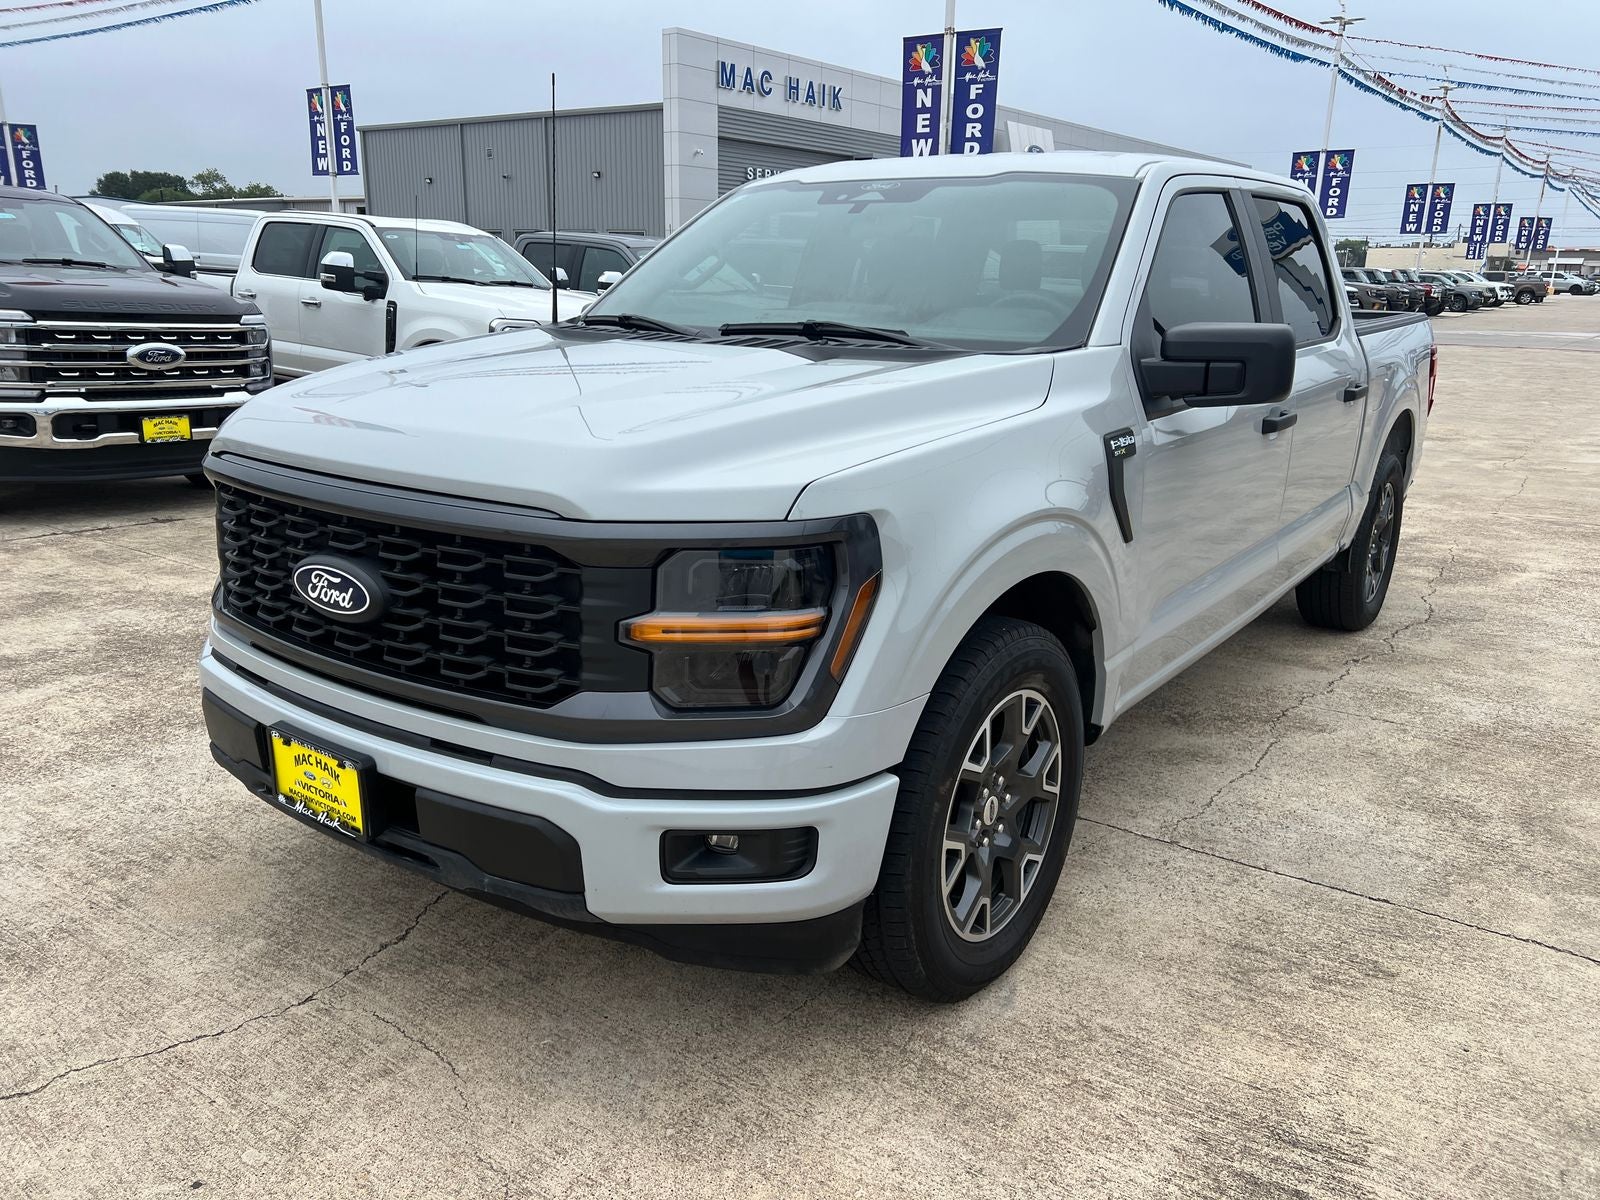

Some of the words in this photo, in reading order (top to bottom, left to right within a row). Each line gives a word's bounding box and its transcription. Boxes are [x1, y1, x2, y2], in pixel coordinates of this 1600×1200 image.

[717, 60, 773, 98] MAC
[785, 75, 842, 110] HAIK
[911, 88, 933, 157] NEW
[963, 84, 984, 156] FORD
[316, 122, 328, 171] NEW
[340, 122, 352, 171] FORD
[22, 150, 37, 187] FORD
[1326, 178, 1342, 216] FORD
[1405, 203, 1419, 232] NEW
[1432, 203, 1445, 232] FORD
[1473, 219, 1484, 242] NEW
[1494, 219, 1504, 242] FORD
[1518, 229, 1528, 249] NEW
[1536, 229, 1545, 249] FORD
[61, 299, 153, 312] SUPER
[159, 302, 217, 313] DUTY
[145, 350, 173, 362] Ford
[1110, 435, 1134, 450] F-150
[308, 570, 353, 609] Ford
[294, 753, 314, 767] MAC
[316, 756, 341, 785] HAIK
[300, 781, 339, 806] VICTORIA
[294, 800, 316, 819] Mac
